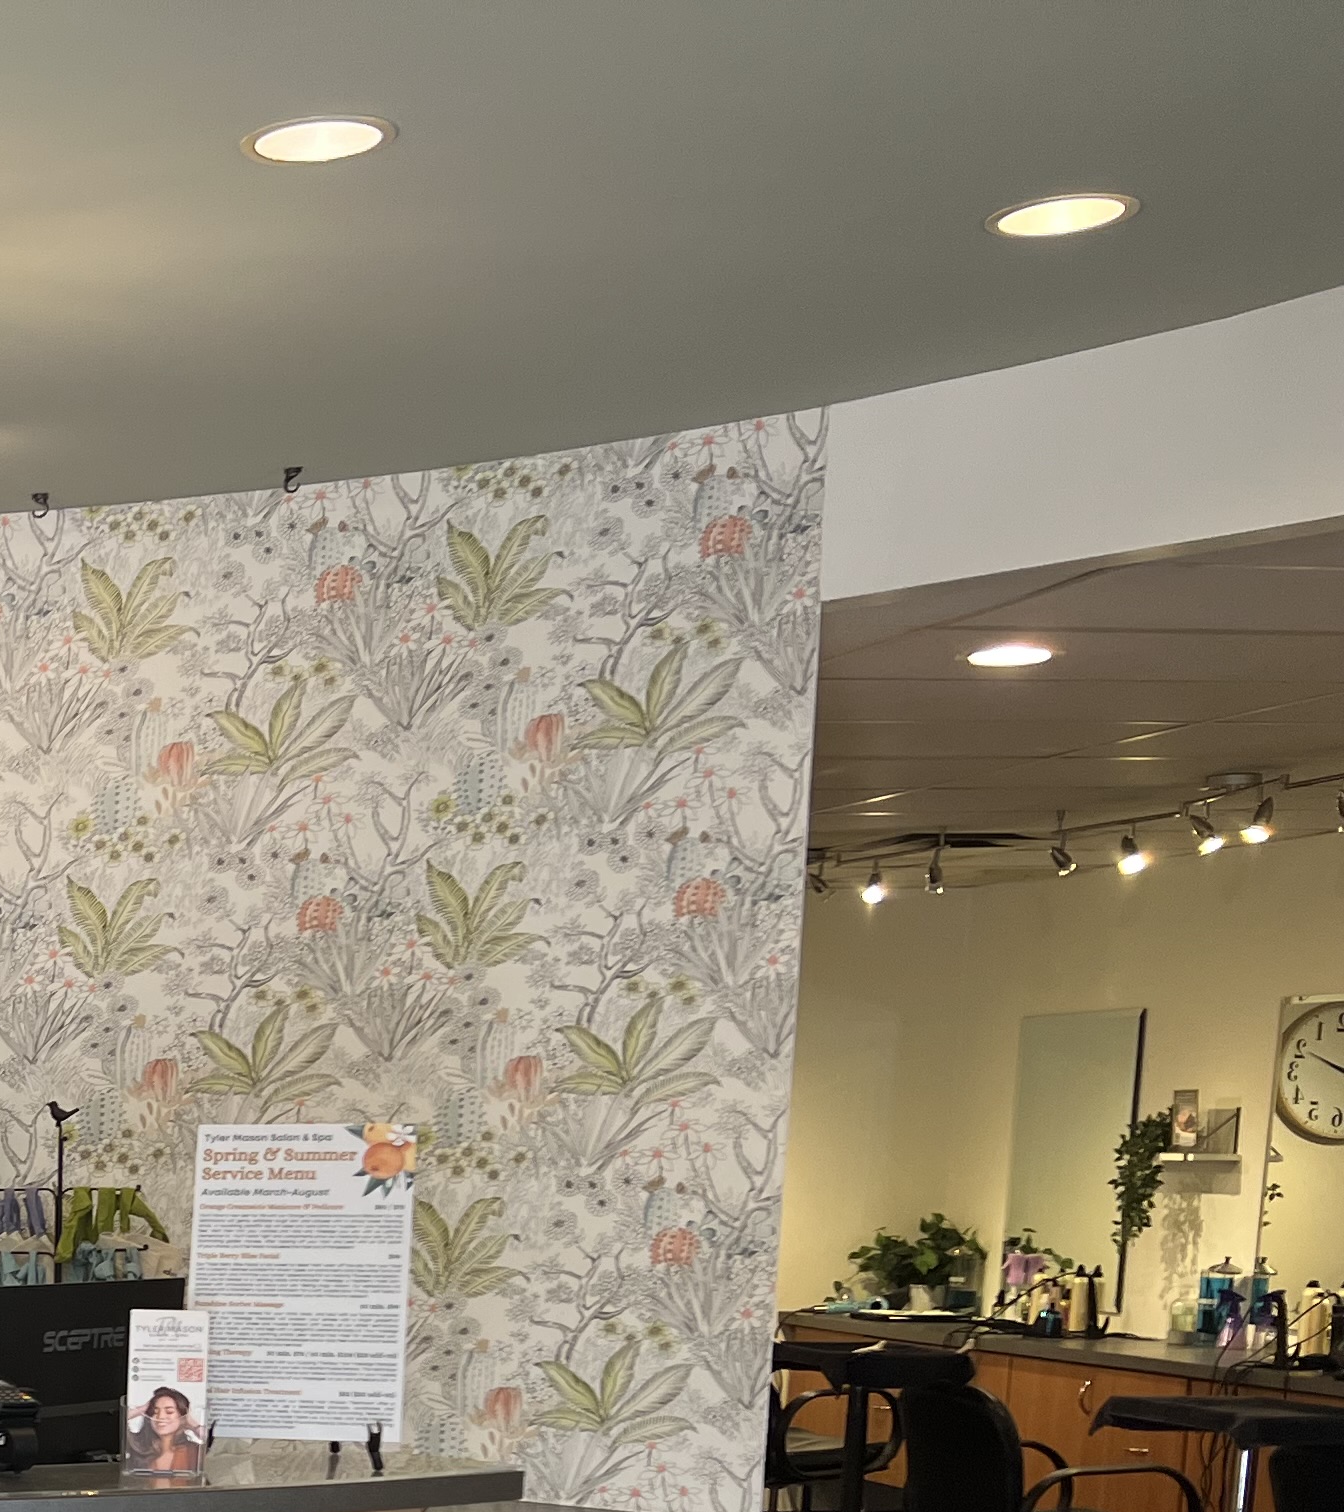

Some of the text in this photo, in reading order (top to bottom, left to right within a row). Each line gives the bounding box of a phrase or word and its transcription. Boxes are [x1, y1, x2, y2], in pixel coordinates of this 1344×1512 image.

[204, 1134, 230, 1144] Tyler
[232, 1134, 268, 1142] Mason
[270, 1134, 300, 1142] Salon
[312, 1134, 333, 1144] Spa
[202, 1147, 358, 1165] Spring & Summer
[202, 1167, 317, 1181] Service Menu
[201, 1188, 330, 1199] Available March-August
[42, 1326, 126, 1353] SCEPTRE
